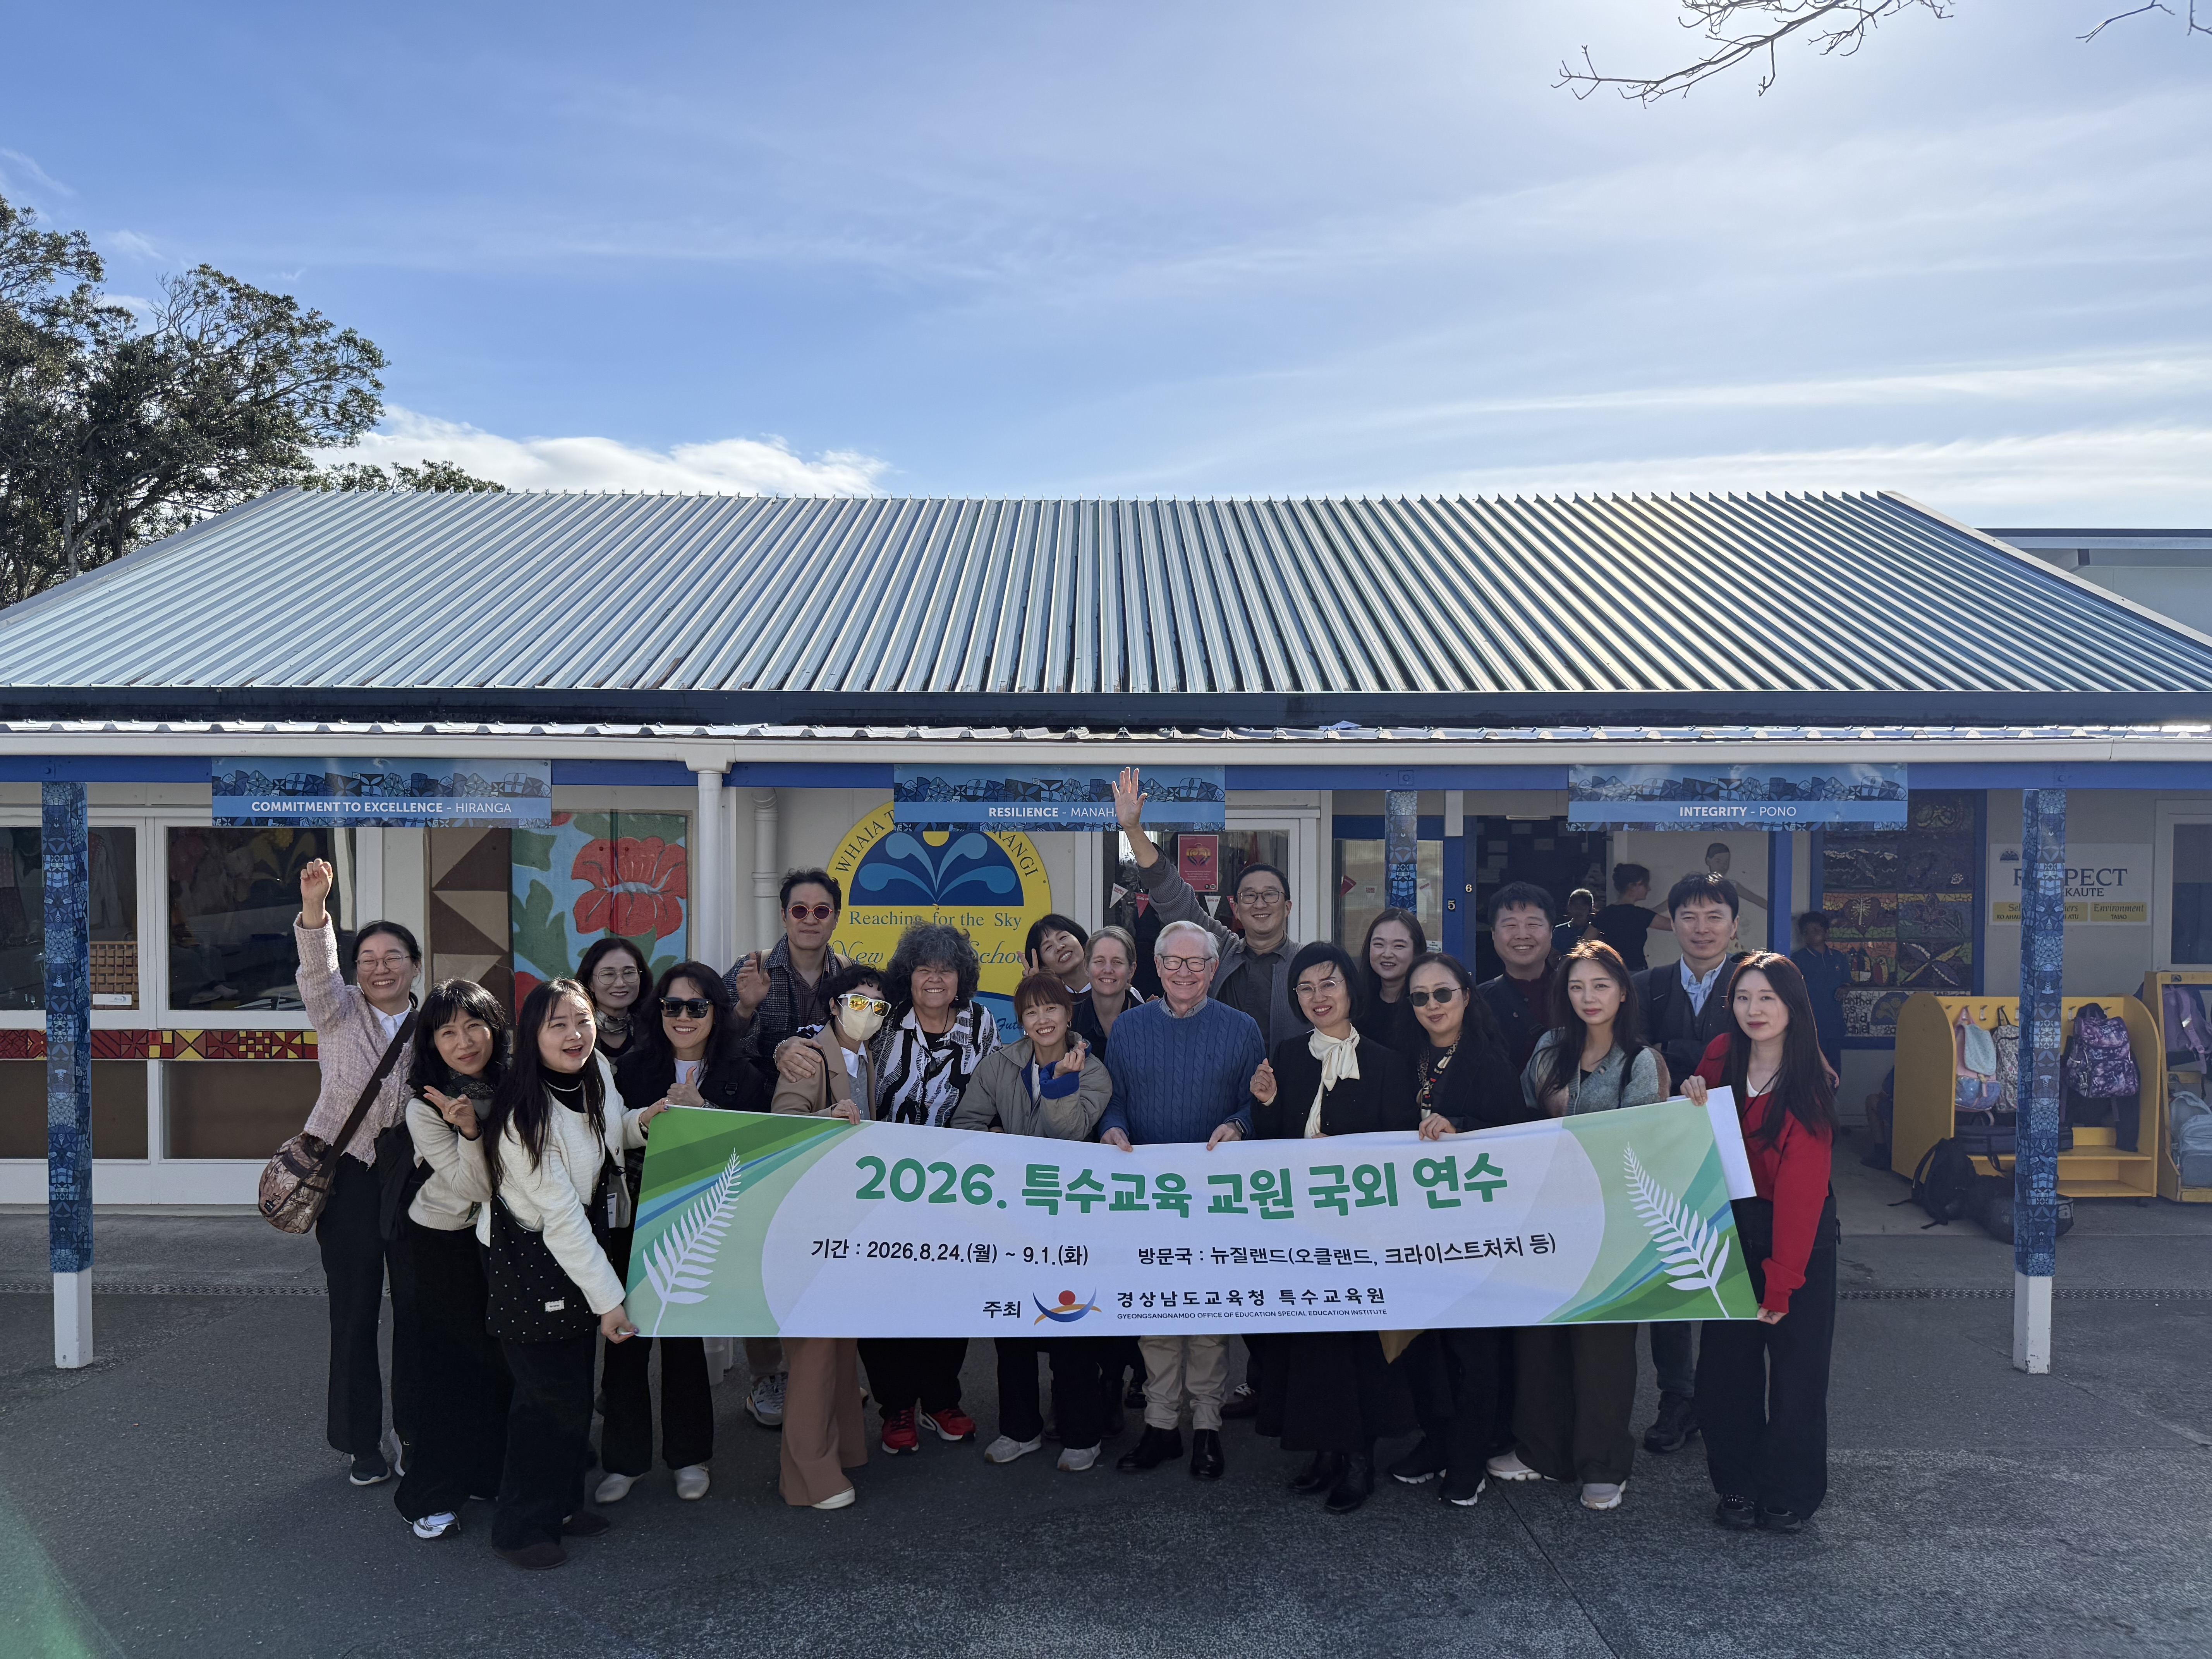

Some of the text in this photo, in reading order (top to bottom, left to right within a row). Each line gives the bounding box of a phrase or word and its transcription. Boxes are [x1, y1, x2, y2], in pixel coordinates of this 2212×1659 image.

[252, 802, 341, 812] COMMITMENT
[343, 802, 361, 812] TO
[365, 802, 443, 812] EXCELLENCE
[456, 803, 512, 812] HIRANGA
[989, 807, 1058, 817] RESILIENCE
[1071, 807, 1117, 817] MANAH
[1680, 807, 1747, 816] INTEGRITY
[1760, 807, 1796, 816] PONO
[835, 809, 1038, 877] WHAIA T ANGI
[2013, 868, 2128, 886] RPECT
[1465, 884, 1472, 892] 6
[2064, 888, 2104, 897] KAUTE
[1448, 900, 1455, 910] 5
[2008, 903, 2021, 912] Sel
[2094, 904, 2144, 912] Environment
[933, 912, 955, 925] for
[960, 912, 984, 926] the
[994, 913, 1022, 931] Sky
[832, 941, 1022, 964] New Scho
[1842, 993, 1872, 1006] antha
[1884, 1026, 1896, 1034] 20
[856, 1152, 1508, 1219] 2026. 특수교육 교원 국외 연수
[811, 1238, 849, 1259] 기간
[867, 1241, 997, 1264] 2026.8.24.(월)
[1023, 1245, 1088, 1266] 9.1.(화)
[1139, 1248, 1193, 1265] 방문국
[1210, 1247, 1377, 1266] 뉴질랜드(오클랜드,
[1385, 1235, 1523, 1265] 크라이스트처치
[1529, 1232, 1556, 1255] 등)
[1117, 1288, 1385, 1308] 경상남도교육청 특수교육원
[983, 1301, 1021, 1318] 주최
